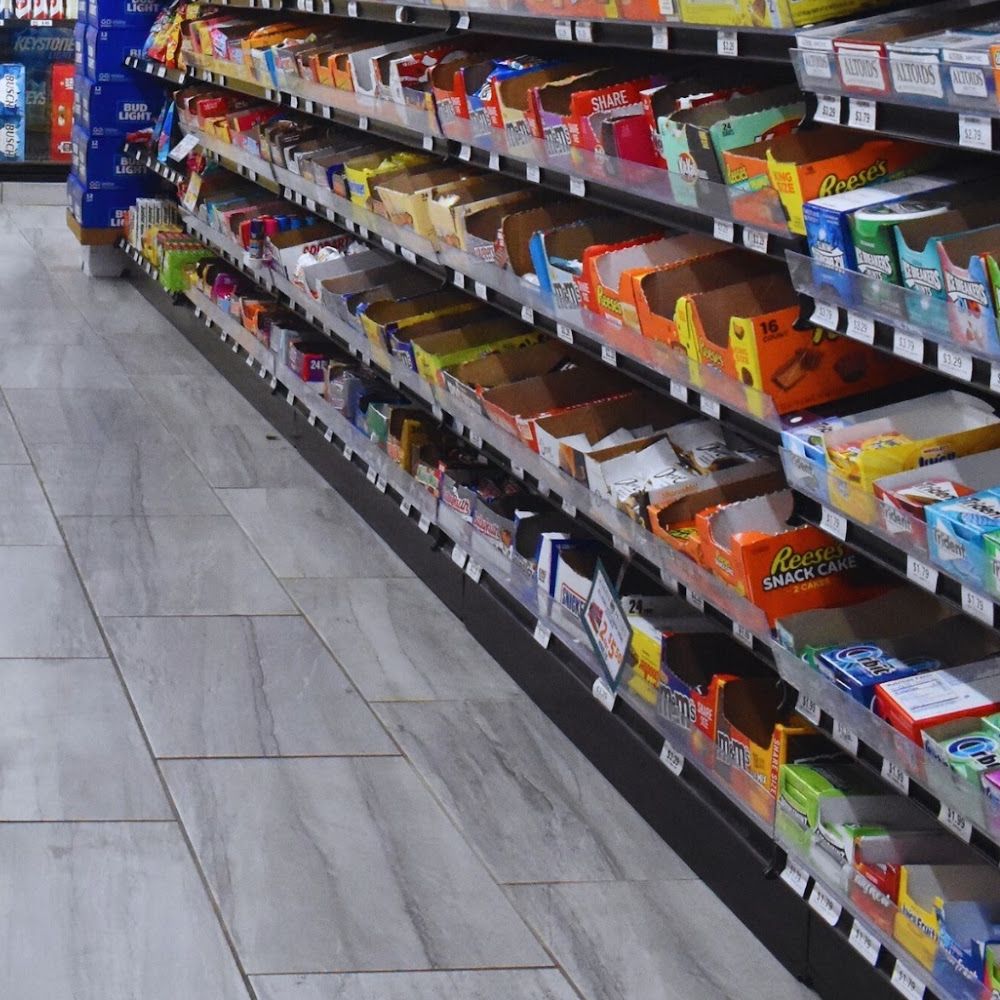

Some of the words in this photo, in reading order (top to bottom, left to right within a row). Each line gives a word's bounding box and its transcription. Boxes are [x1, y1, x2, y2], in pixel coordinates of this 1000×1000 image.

[126, 3, 161, 13] LIGHT
[14, 36, 75, 52] KEYSTONE
[843, 56, 880, 79] ALTOIDS
[896, 60, 937, 86] ALTOIDS
[952, 71, 985, 87] ALTOIDS
[4, 74, 16, 109] BUSCH
[590, 89, 628, 112] SHARE
[118, 111, 152, 121] LIGHT
[123, 102, 149, 113] BUD
[722, 122, 731, 131] 24
[4, 123, 16, 158] BUSCH
[115, 165, 148, 175] LIGHT
[773, 170, 793, 183] KING
[818, 160, 889, 199] Reese's
[776, 181, 795, 195] SIZE
[759, 319, 780, 334] 16
[942, 353, 963, 369] $3.29
[771, 542, 844, 573] Reese's
[762, 566, 816, 591] SNACK
[815, 555, 857, 577] CAKE
[793, 585, 800, 594] 2
[628, 599, 644, 616] 24
[836, 645, 896, 677] Orbit
[656, 684, 698, 729] m&m's
[717, 729, 752, 771] m&m's
[773, 737, 781, 767] SHARE
[947, 736, 1000, 768] Orb
[770, 769, 779, 799] SIZE
